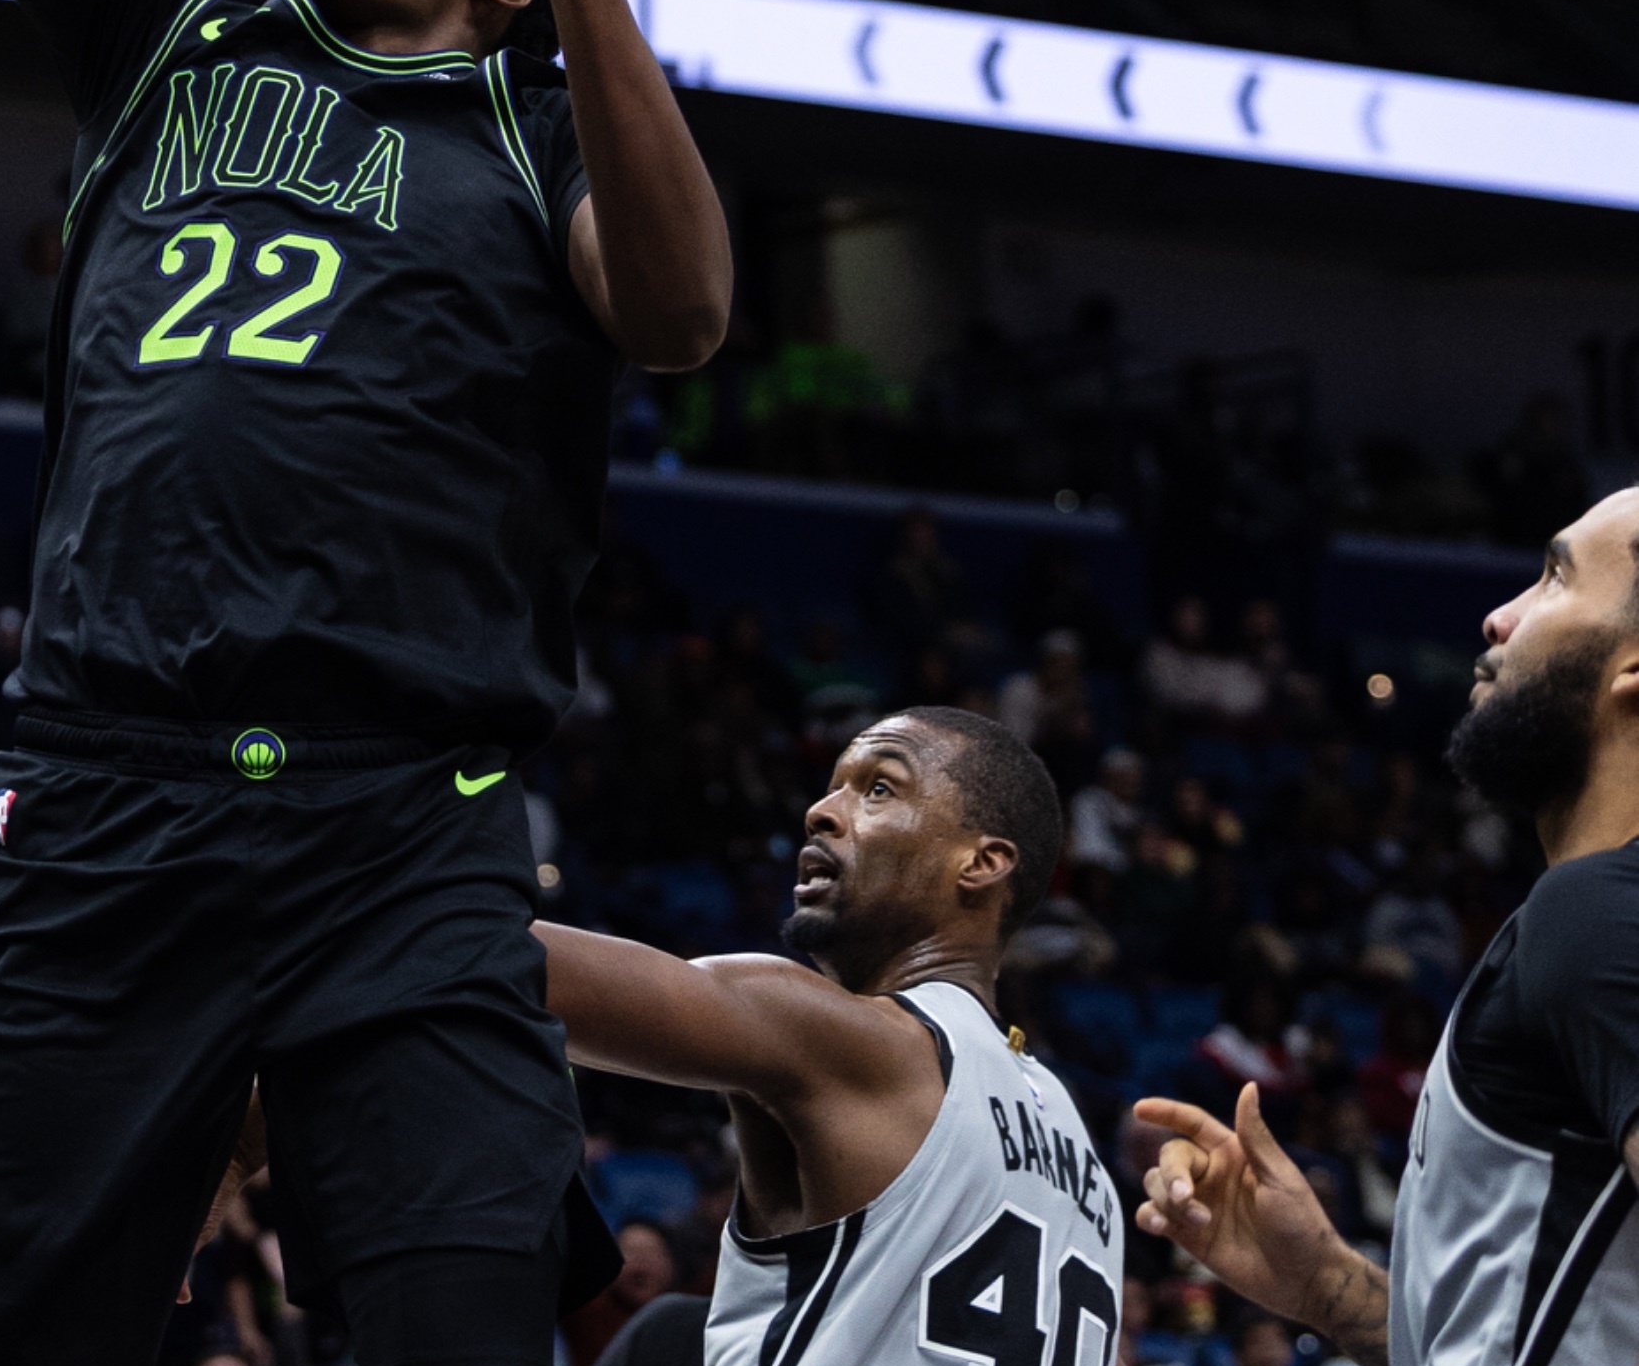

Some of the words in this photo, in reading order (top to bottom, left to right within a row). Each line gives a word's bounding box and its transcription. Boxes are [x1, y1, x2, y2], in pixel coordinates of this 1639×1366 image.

[142, 63, 407, 232] NOLA
[134, 217, 348, 371] 22
[988, 1095, 1113, 1248] BARNES
